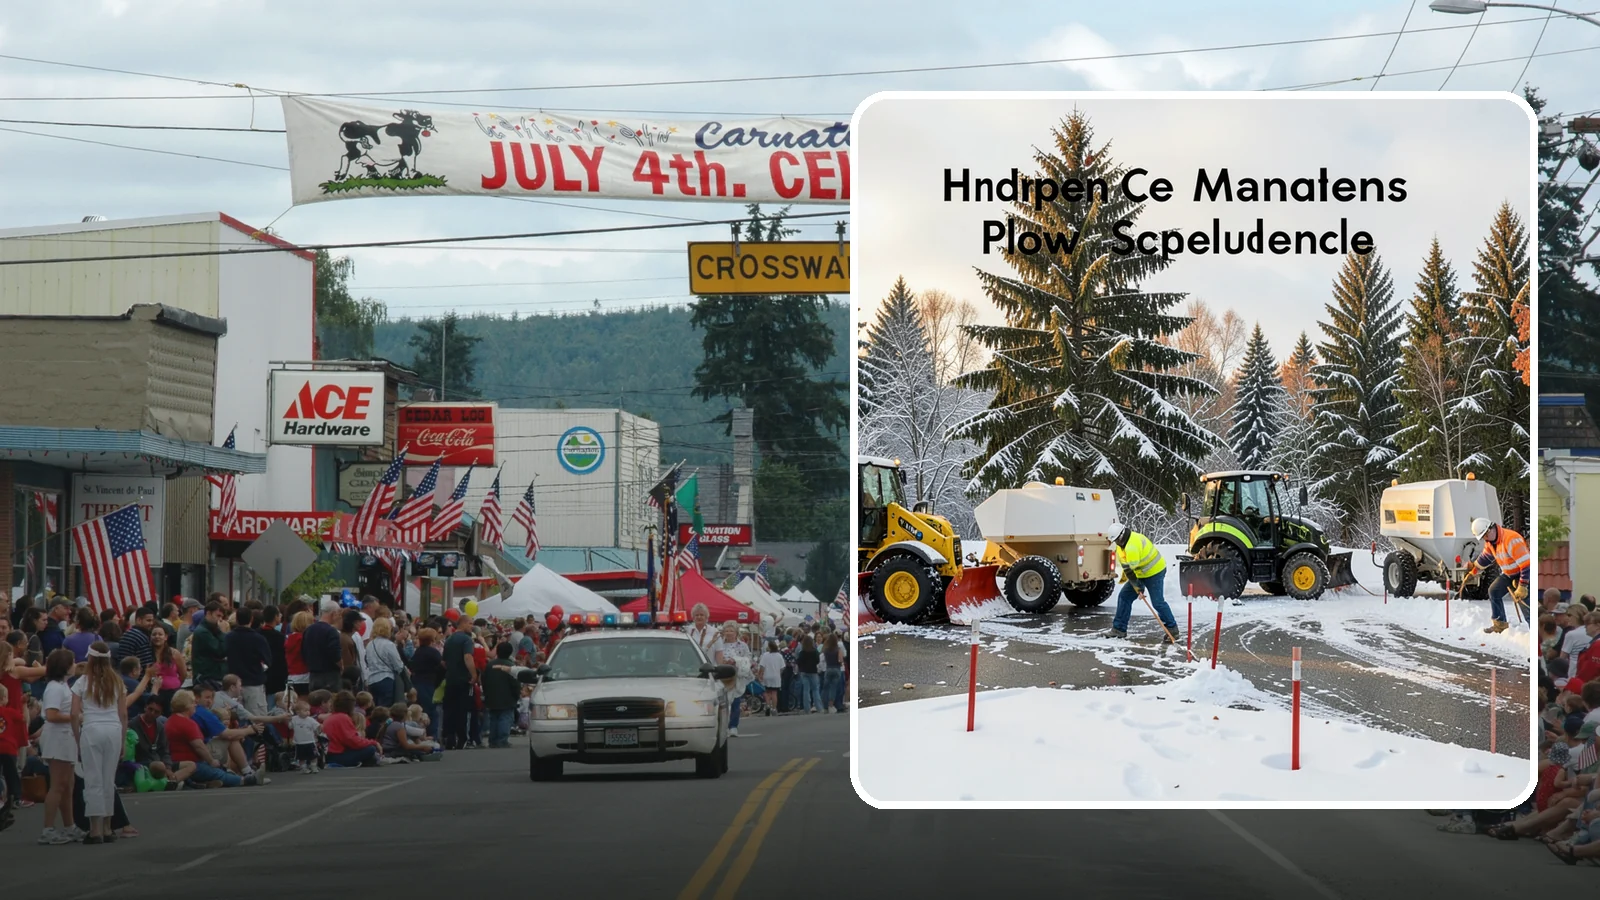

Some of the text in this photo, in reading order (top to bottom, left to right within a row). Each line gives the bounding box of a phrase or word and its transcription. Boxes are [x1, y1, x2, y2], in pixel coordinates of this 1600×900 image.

[694, 121, 850, 149] Carnat
[481, 141, 605, 193] JULY
[632, 150, 746, 197] 4th.
[697, 254, 850, 280] CROSSWA
[283, 380, 373, 420] ACE
[405, 410, 452, 422] CEDAR
[284, 421, 370, 436] Hardware
[416, 428, 477, 447] Coca-Cola
[353, 467, 385, 480] Simpl
[96, 485, 124, 494] Vincent
[126, 486, 135, 494] de
[138, 486, 155, 495] Paul
[688, 526, 741, 535] CRNATION
[699, 535, 730, 543] GLASS
